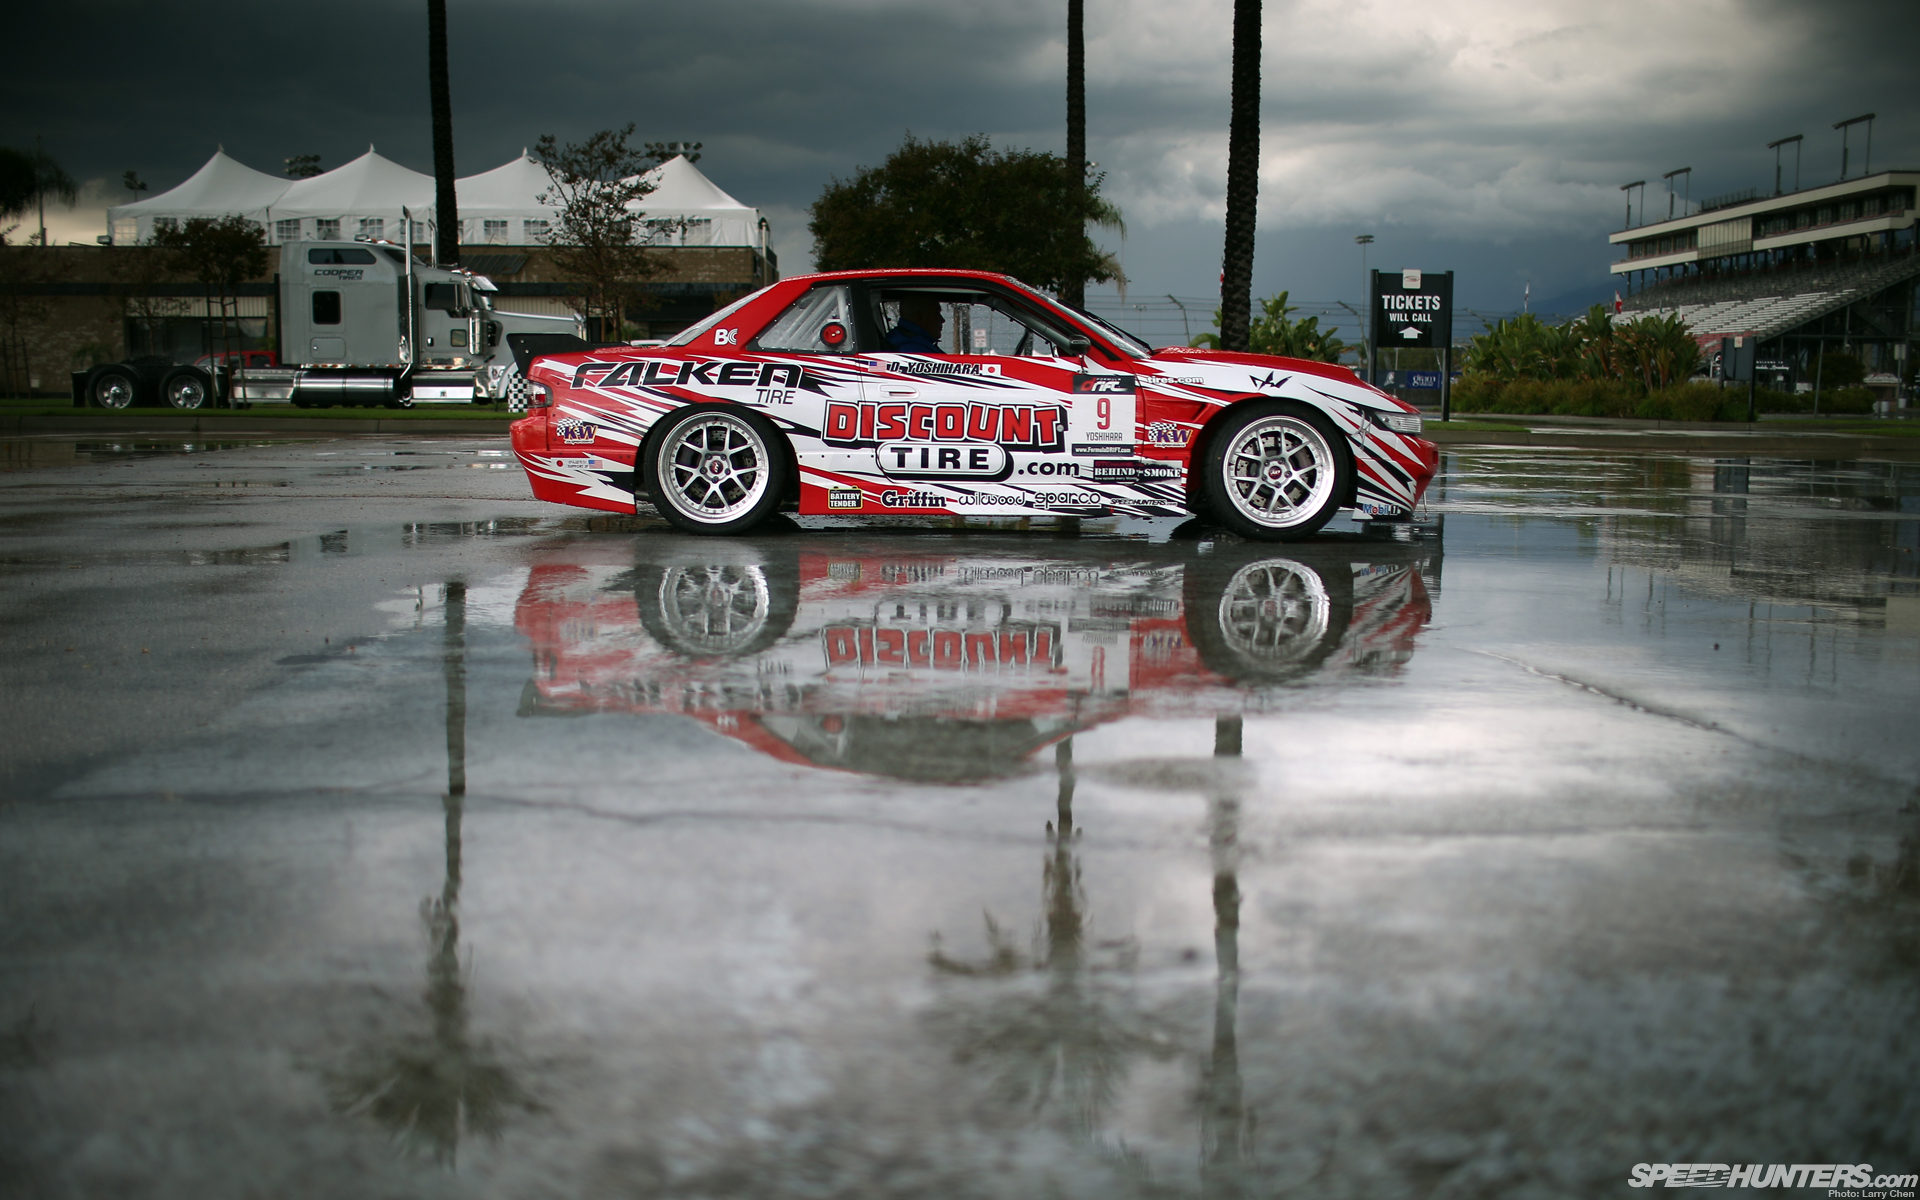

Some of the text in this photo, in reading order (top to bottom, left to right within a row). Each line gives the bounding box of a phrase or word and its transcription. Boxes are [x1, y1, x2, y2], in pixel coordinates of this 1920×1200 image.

[1382, 295, 1440, 310] TICKETS
[1389, 313, 1432, 322] WILL CALL
[570, 361, 803, 389] FALKEN
[890, 361, 981, 375] D. YOSHIHARA
[756, 388, 796, 405] TIRE
[1097, 398, 1111, 429] 9
[564, 425, 597, 440] KW
[822, 399, 1067, 453] DISCOUNT
[1086, 432, 1123, 441] YOSHIHARA
[1157, 429, 1193, 444] KW
[890, 447, 991, 469] TIRE
[1095, 468, 1136, 476] BEHIND
[1144, 469, 1181, 477] SMOKE
[882, 491, 947, 507] Griffin
[959, 491, 1026, 506] wilwood
[1034, 492, 1101, 509] sparco
[1363, 504, 1389, 514] Mobil
